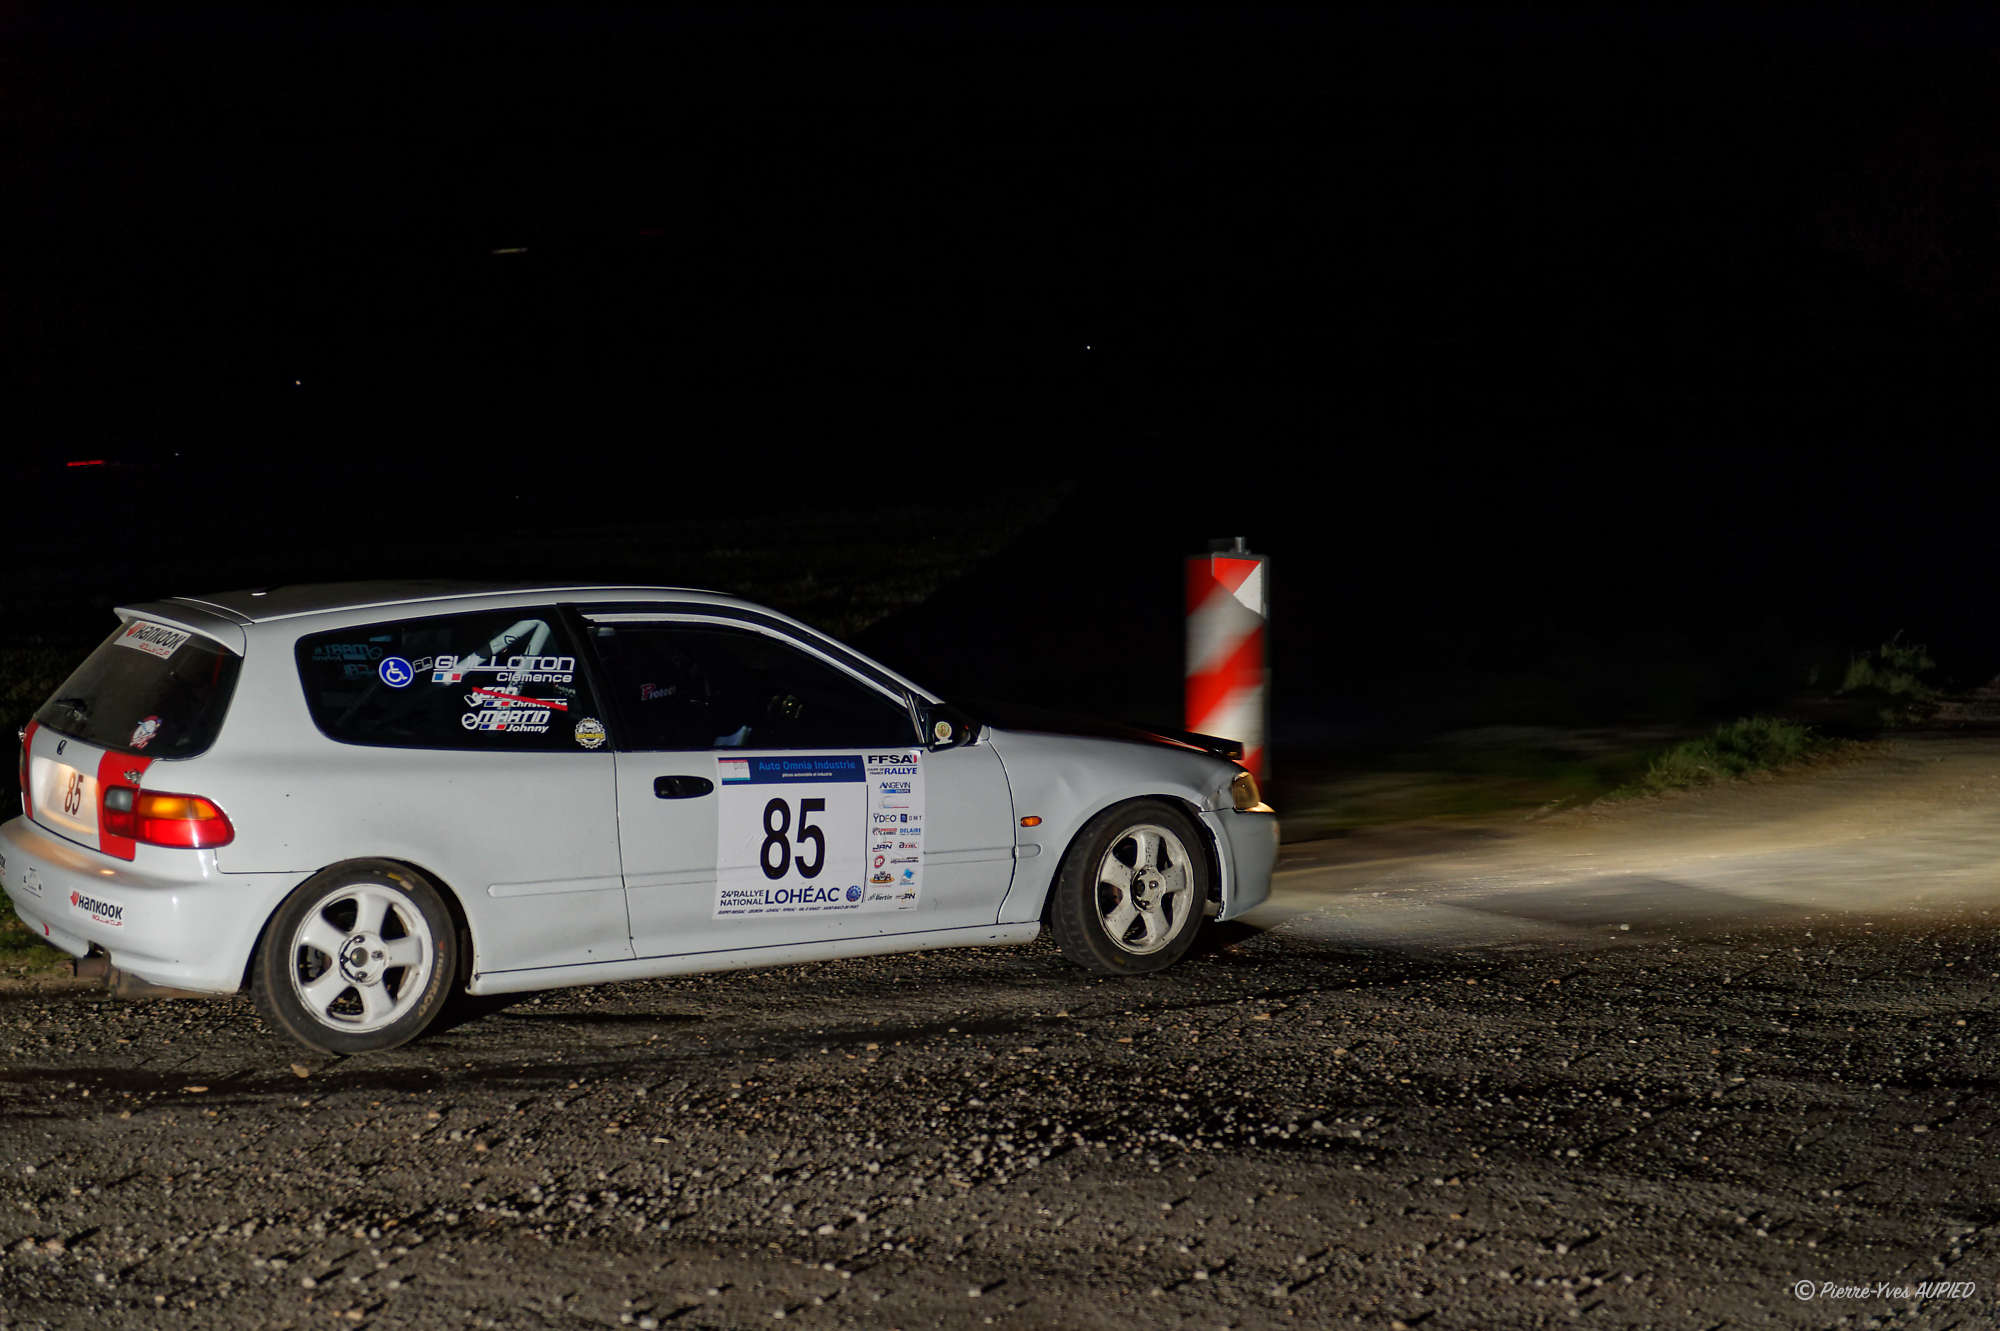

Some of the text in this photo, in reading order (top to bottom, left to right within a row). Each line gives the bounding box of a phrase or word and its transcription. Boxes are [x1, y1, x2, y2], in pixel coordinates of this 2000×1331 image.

[478, 710, 551, 724] MARTIN
[506, 724, 549, 733] Johnny
[867, 754, 913, 764] FFSA
[884, 767, 918, 775] RALLYE
[64, 771, 84, 816] 85
[760, 797, 826, 880] 85
[734, 889, 764, 898] RALLYE
[764, 886, 840, 905] LOHÉAC
[720, 898, 763, 907] NATIONAL
